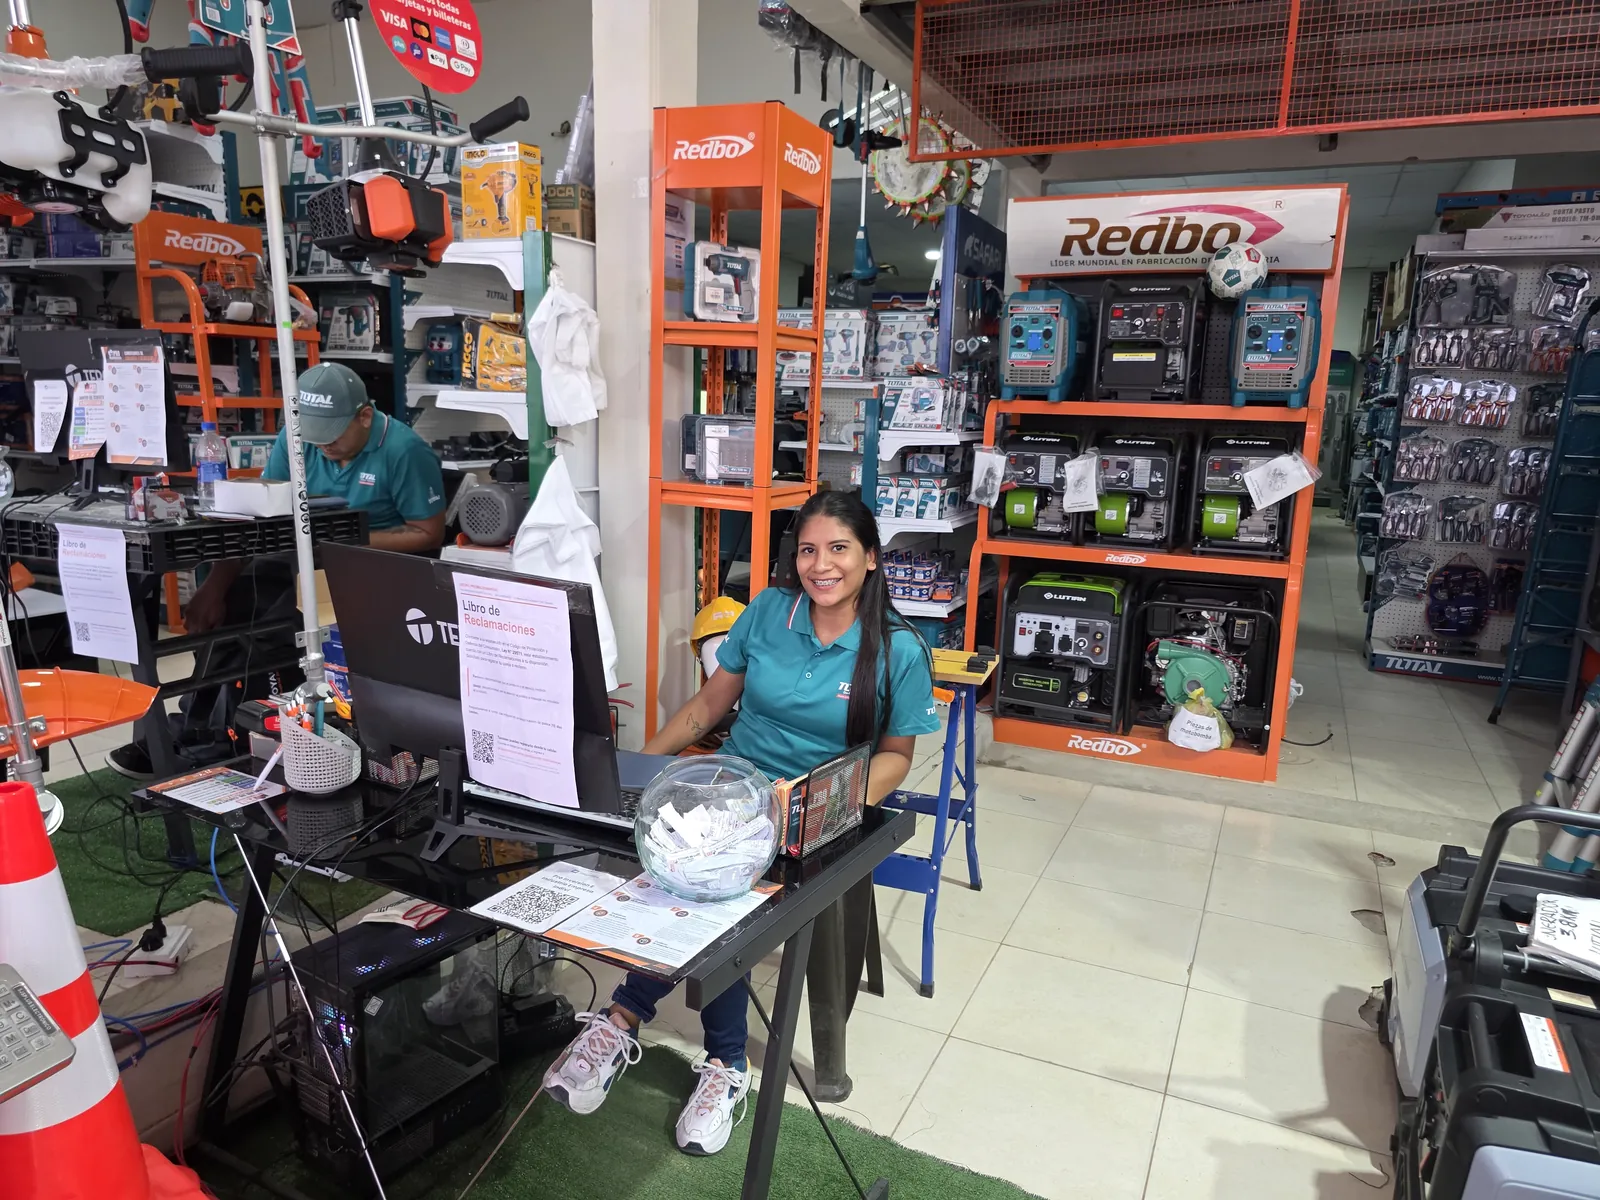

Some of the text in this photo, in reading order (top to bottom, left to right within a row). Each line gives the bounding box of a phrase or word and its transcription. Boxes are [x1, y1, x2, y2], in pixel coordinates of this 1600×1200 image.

[436, 0, 460, 15] todas
[380, 8, 408, 30] VISA
[427, 7, 432, 16] y
[433, 8, 472, 31] billeteras
[673, 140, 740, 160] Redbo
[784, 142, 815, 175] Redbo
[548, 187, 575, 198] DCA
[164, 229, 233, 256] Redbo
[1060, 216, 1242, 256] Redbo
[726, 262, 742, 270] TOTAL
[1050, 259, 1075, 267] LÍDER
[1136, 256, 1198, 265] FABRICACIÓN
[486, 290, 509, 301] TOTAL
[299, 391, 333, 405] TOTAL
[360, 472, 376, 481] TOTAL
[62, 540, 86, 549] Libro de
[1105, 554, 1139, 564] Redbo
[1053, 594, 1087, 602] LUTIAN
[462, 600, 500, 617] Libro de
[464, 613, 536, 637] Reclamaciones
[1386, 656, 1443, 675] TOTAL
[1186, 720, 1205, 730] Piezas
[1180, 727, 1212, 740] motobomba
[1067, 734, 1128, 756] Redbo
